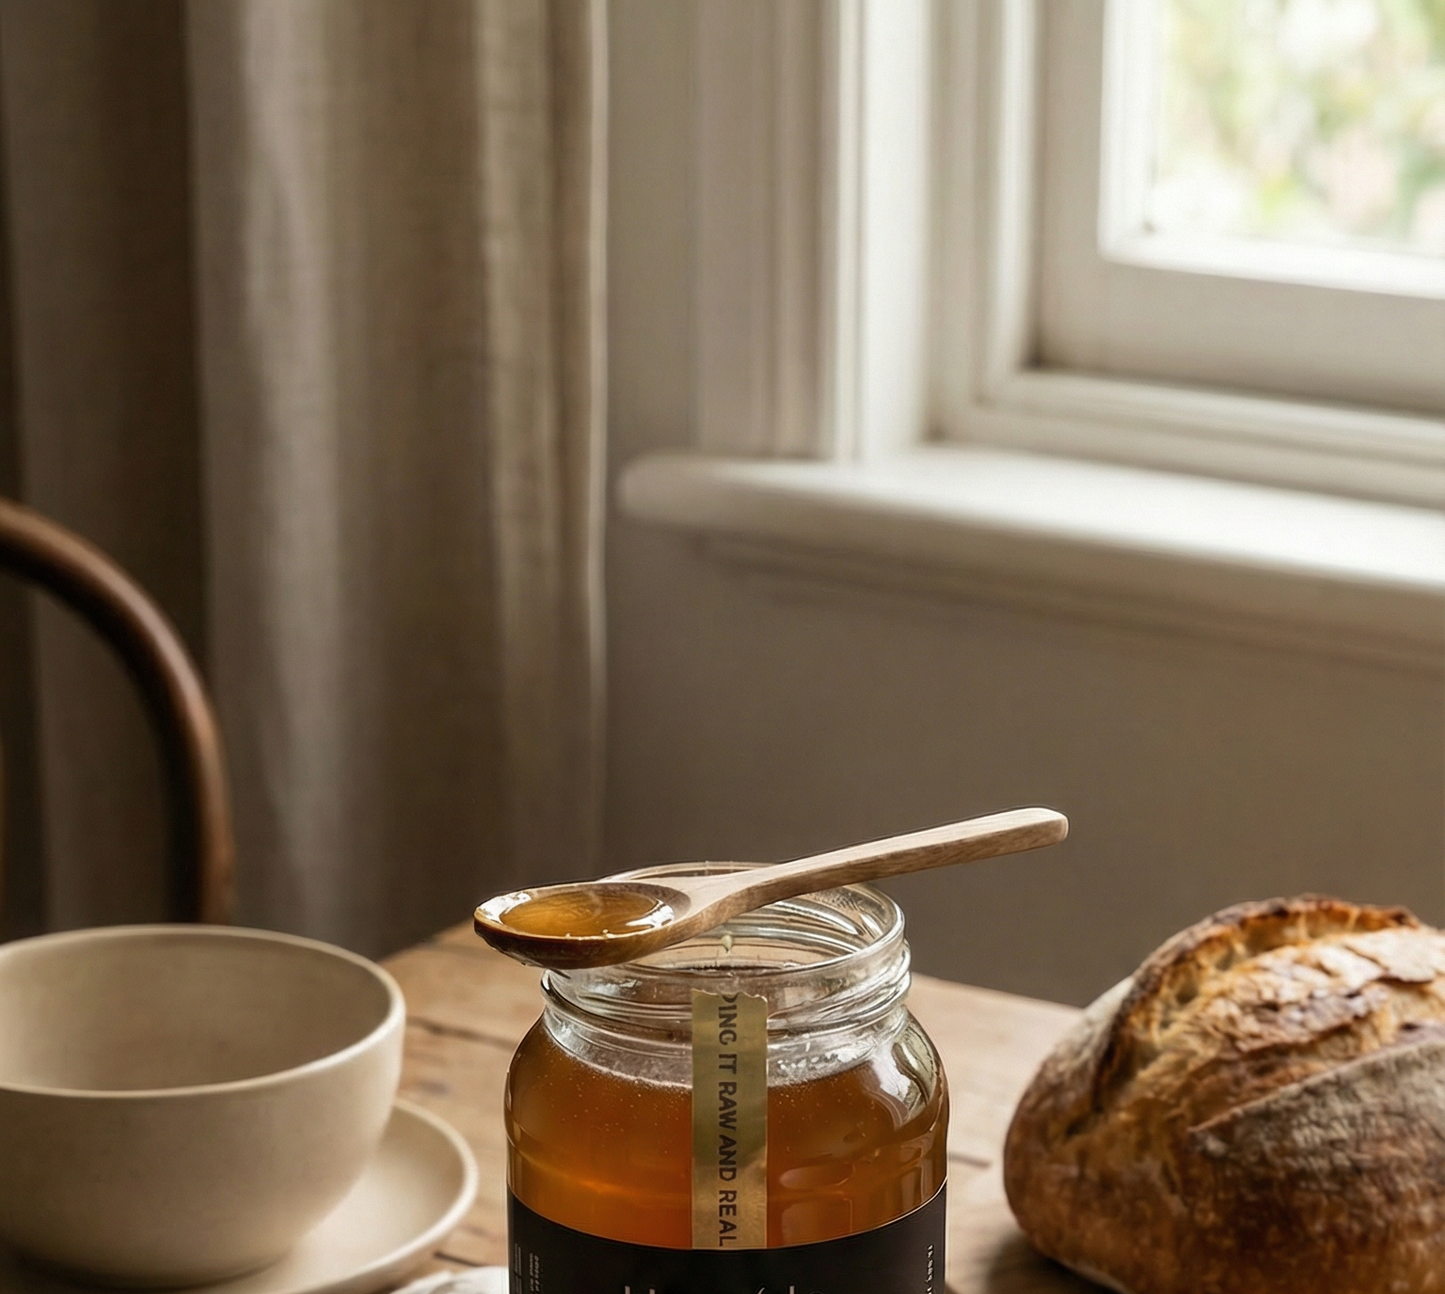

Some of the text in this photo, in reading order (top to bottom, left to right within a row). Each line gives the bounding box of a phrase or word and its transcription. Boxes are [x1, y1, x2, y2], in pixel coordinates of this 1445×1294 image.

[718, 1053, 737, 1075] IT
[718, 1081, 737, 1131] RAW
[718, 1134, 737, 1182] AND
[718, 1190, 737, 1247] REAL
